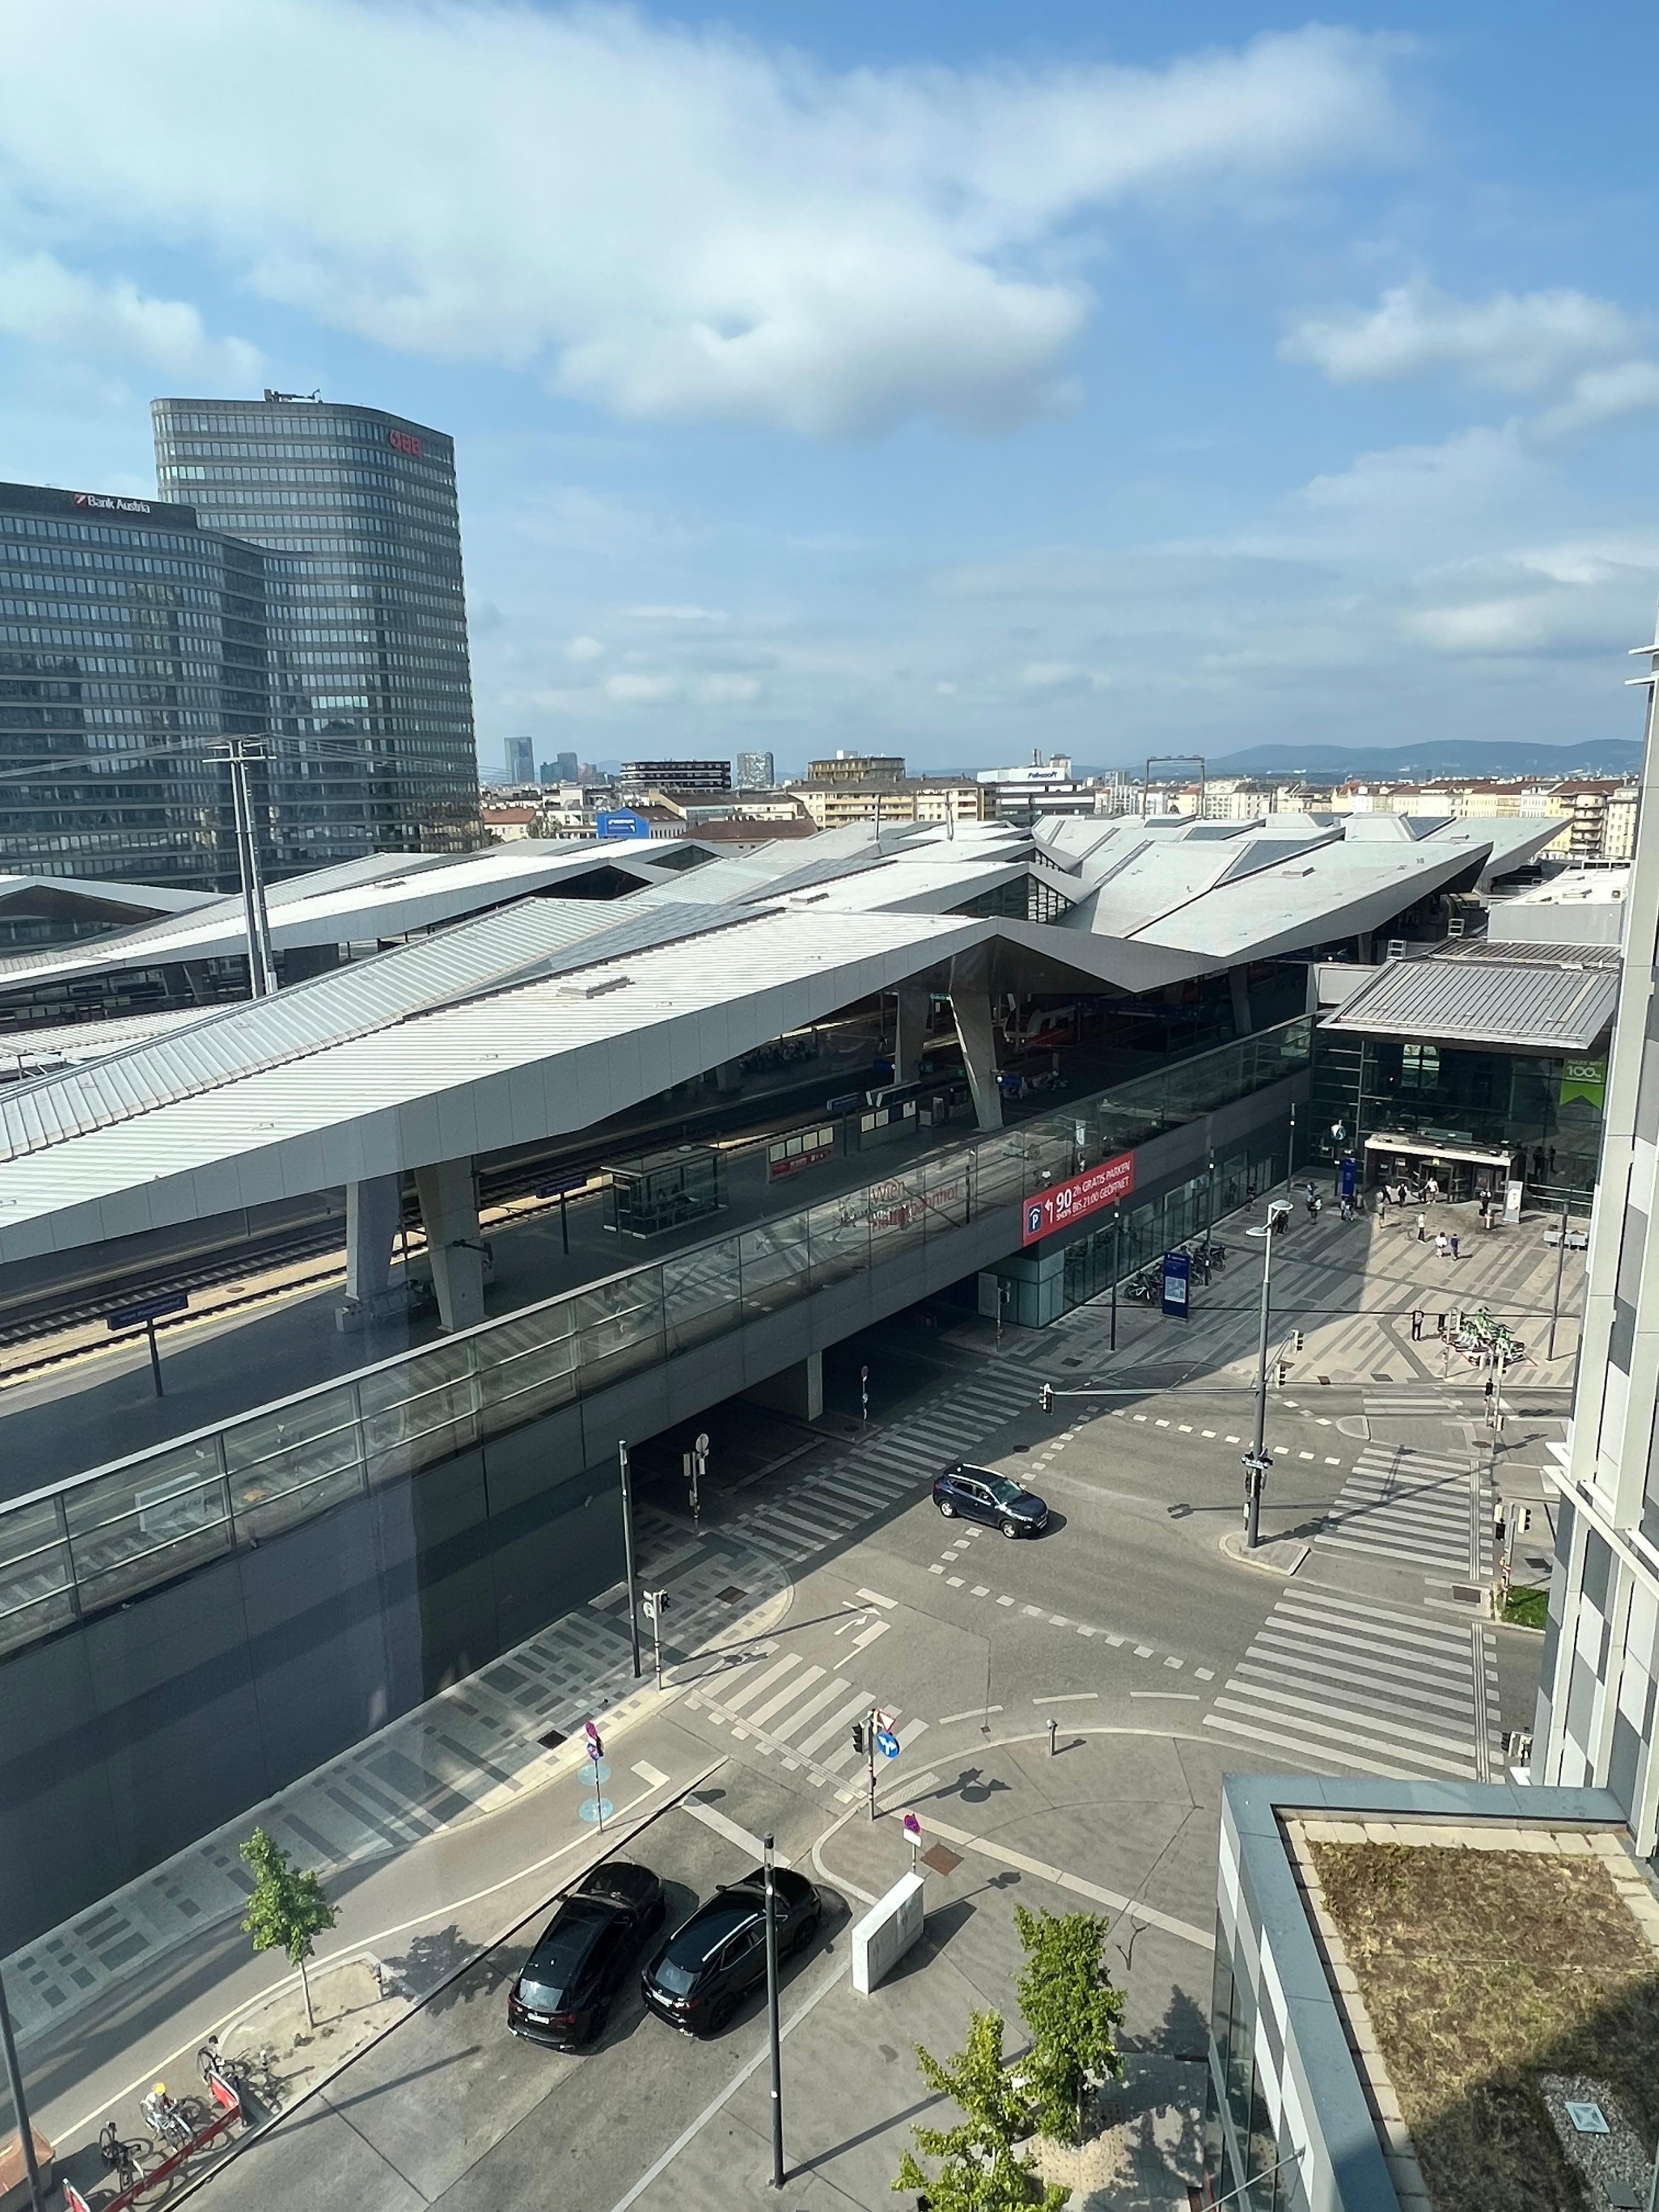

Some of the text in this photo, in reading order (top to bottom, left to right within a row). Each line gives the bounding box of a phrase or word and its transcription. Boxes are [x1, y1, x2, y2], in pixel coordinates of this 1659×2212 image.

[88, 495, 150, 514] Bank Austria
[1082, 1172, 1105, 1193] GRATIS
[1106, 1160, 1131, 1180] PARKEN
[1056, 1188, 1072, 1213] 90
